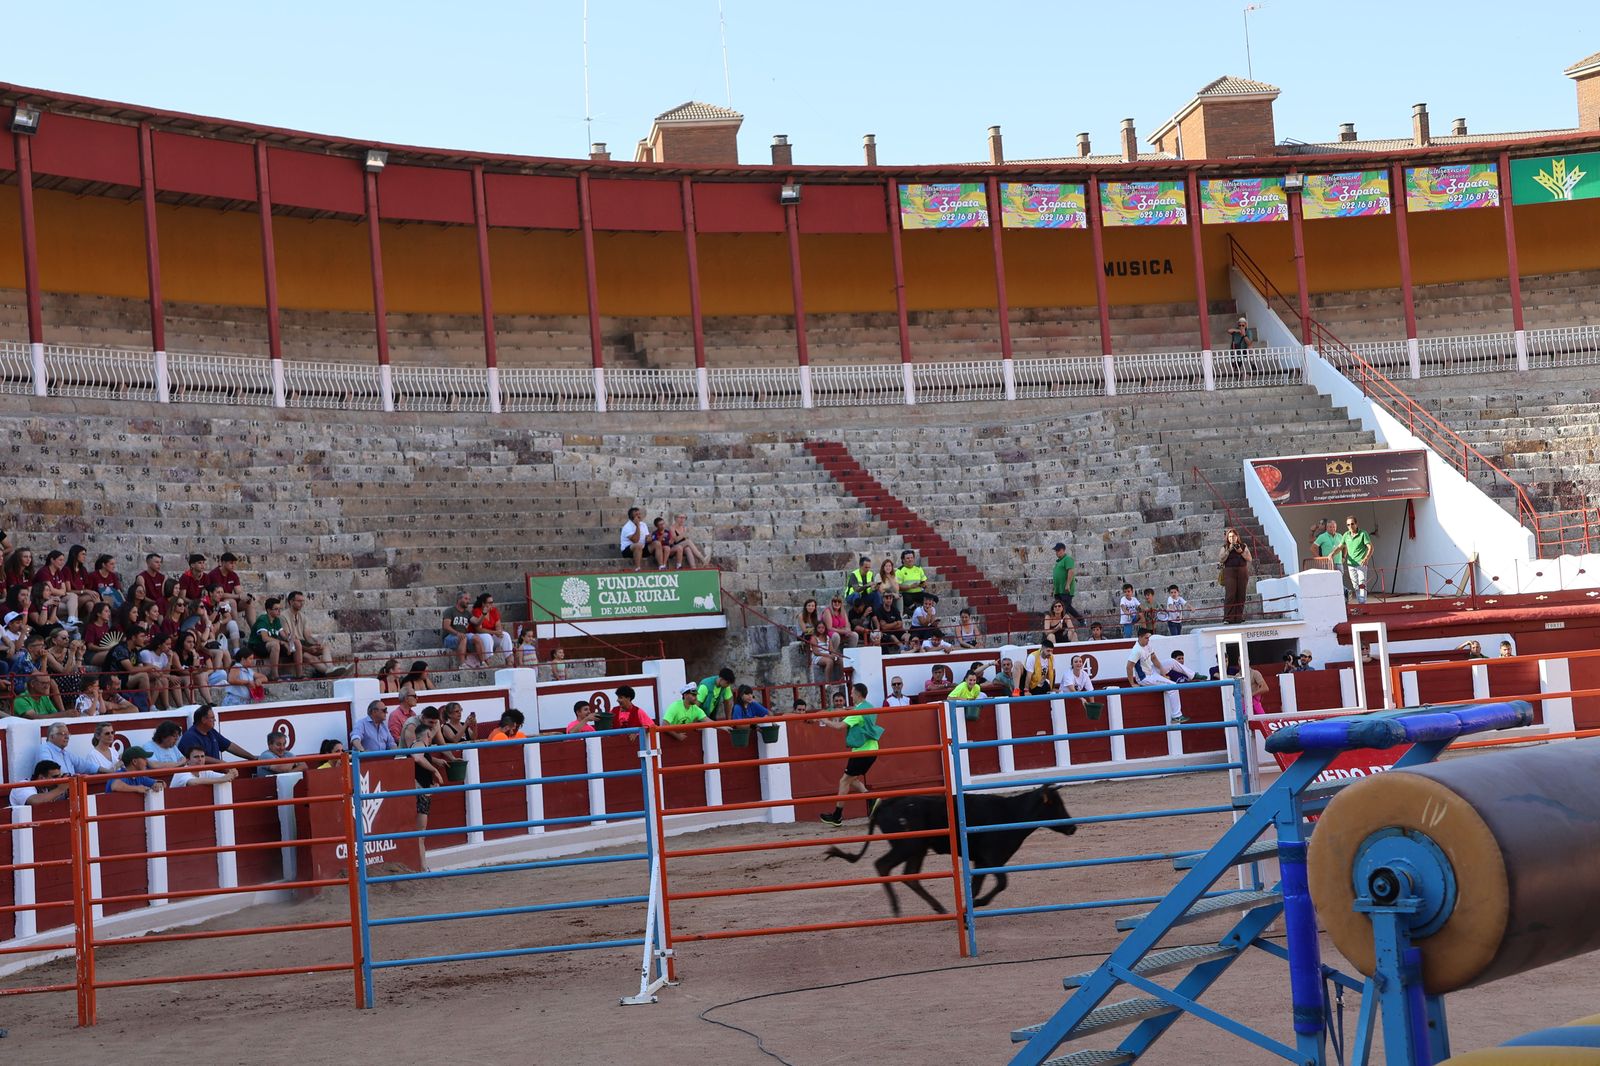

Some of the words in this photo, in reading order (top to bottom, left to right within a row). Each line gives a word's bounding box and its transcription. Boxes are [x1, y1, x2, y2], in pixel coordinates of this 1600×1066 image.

[1339, 186, 1380, 201] Zapata
[1446, 179, 1489, 194] Zapata
[939, 197, 980, 212] Zapata
[1038, 197, 1077, 212] Zapata
[1138, 195, 1176, 210] Zapata
[1239, 192, 1280, 207] Zapata
[1104, 260, 1173, 276] MUSICA
[50, 466, 60, 474] 55
[1304, 478, 1342, 490] PUENTE
[597, 575, 679, 590] FUNDACION
[599, 592, 632, 604] CAJA
[635, 590, 680, 602] RURAL
[614, 606, 648, 615] ZAMORA
[1082, 658, 1092, 677] 4
[364, 856, 384, 866] AMORA
